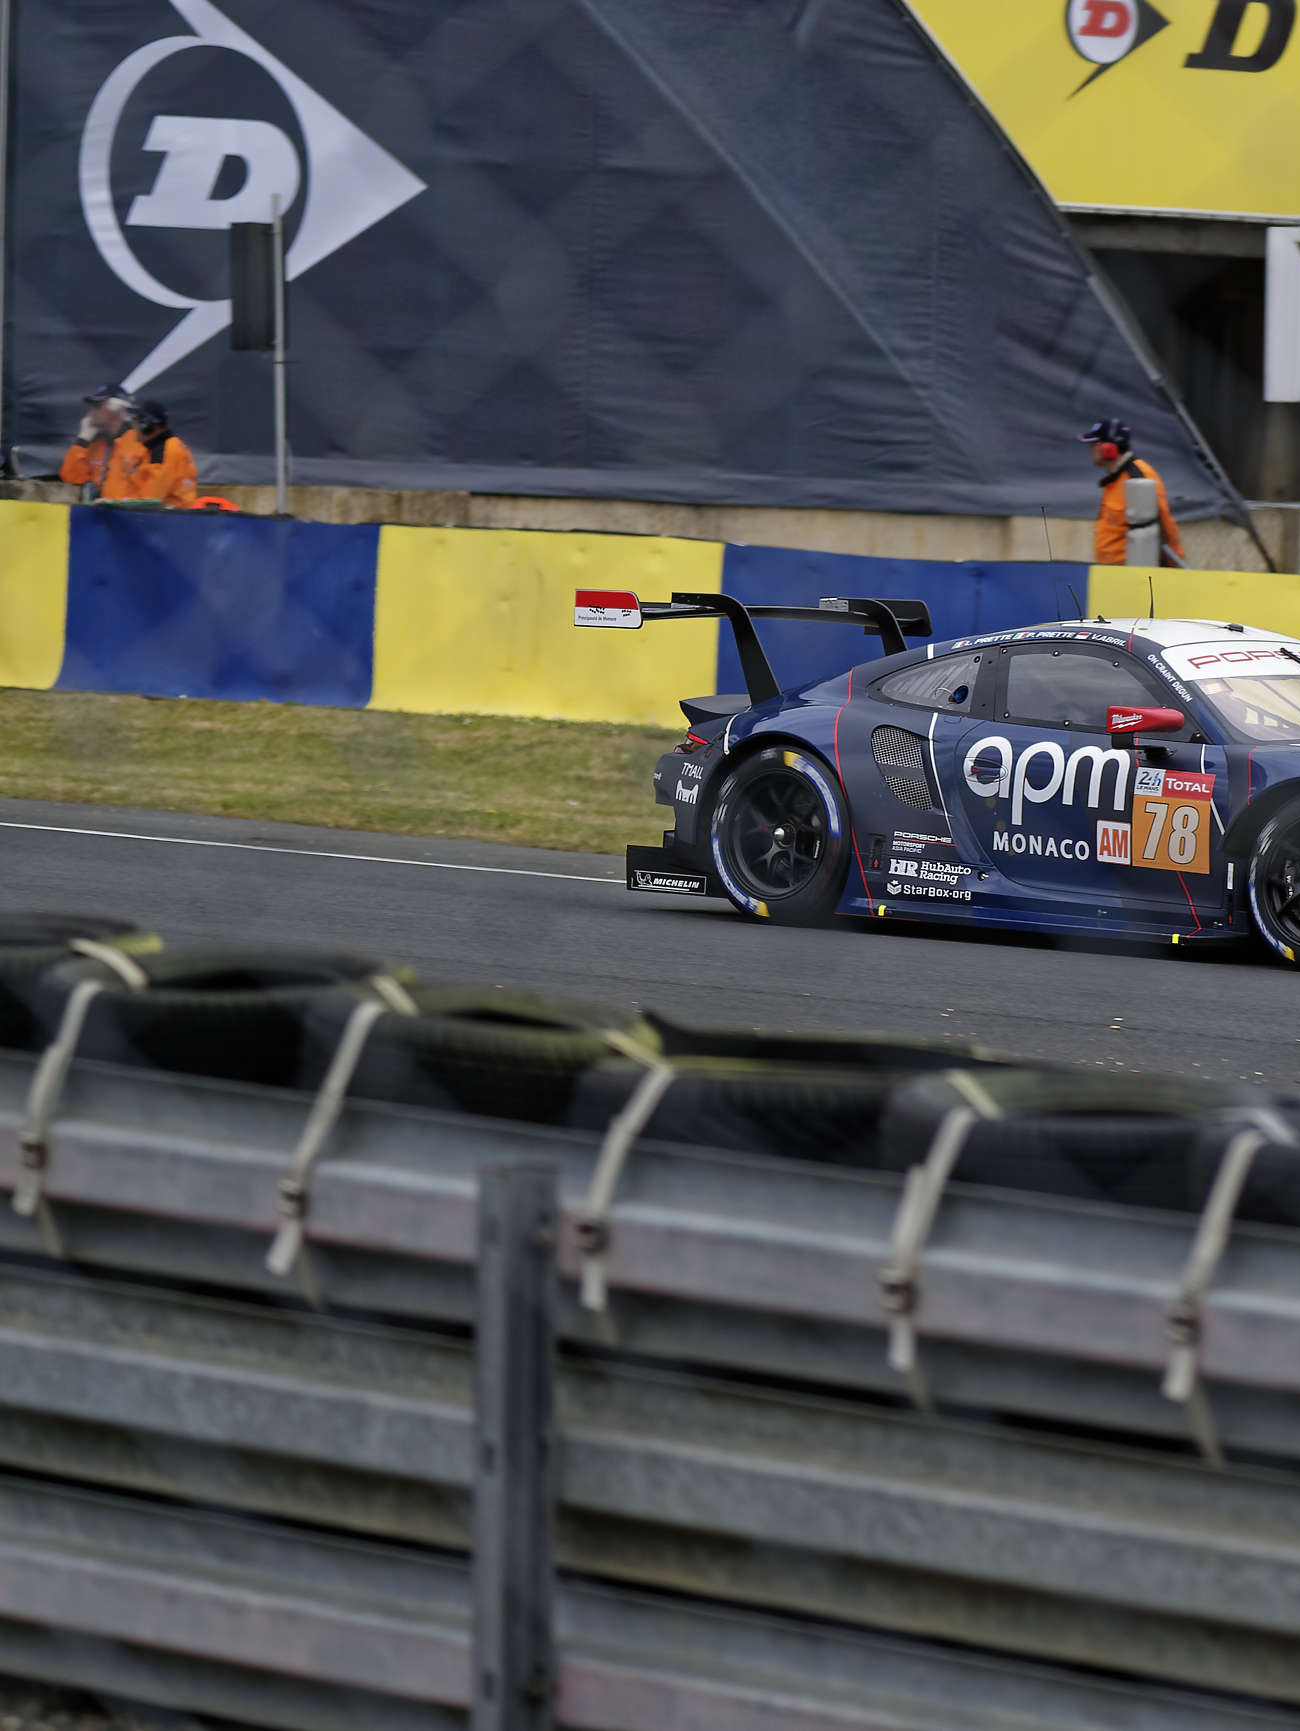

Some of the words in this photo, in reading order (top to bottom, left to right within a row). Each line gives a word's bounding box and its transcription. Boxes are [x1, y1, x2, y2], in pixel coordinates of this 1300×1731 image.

[1079, 0, 1131, 38] D
[125, 115, 301, 230] D
[974, 633, 1012, 645] PRETTE
[1154, 661, 1177, 687] CRAINT
[681, 762, 703, 780] TMALL
[963, 736, 1130, 825] apm
[1165, 777, 1210, 793] TOTAL
[893, 831, 952, 844] PORSCHE
[1100, 827, 1129, 859] AM
[1142, 801, 1200, 865] 78
[993, 831, 1090, 861] MONACO
[919, 870, 959, 885] Racing
[920, 861, 972, 875] HubAuto
[653, 877, 700, 889] MICHELIN
